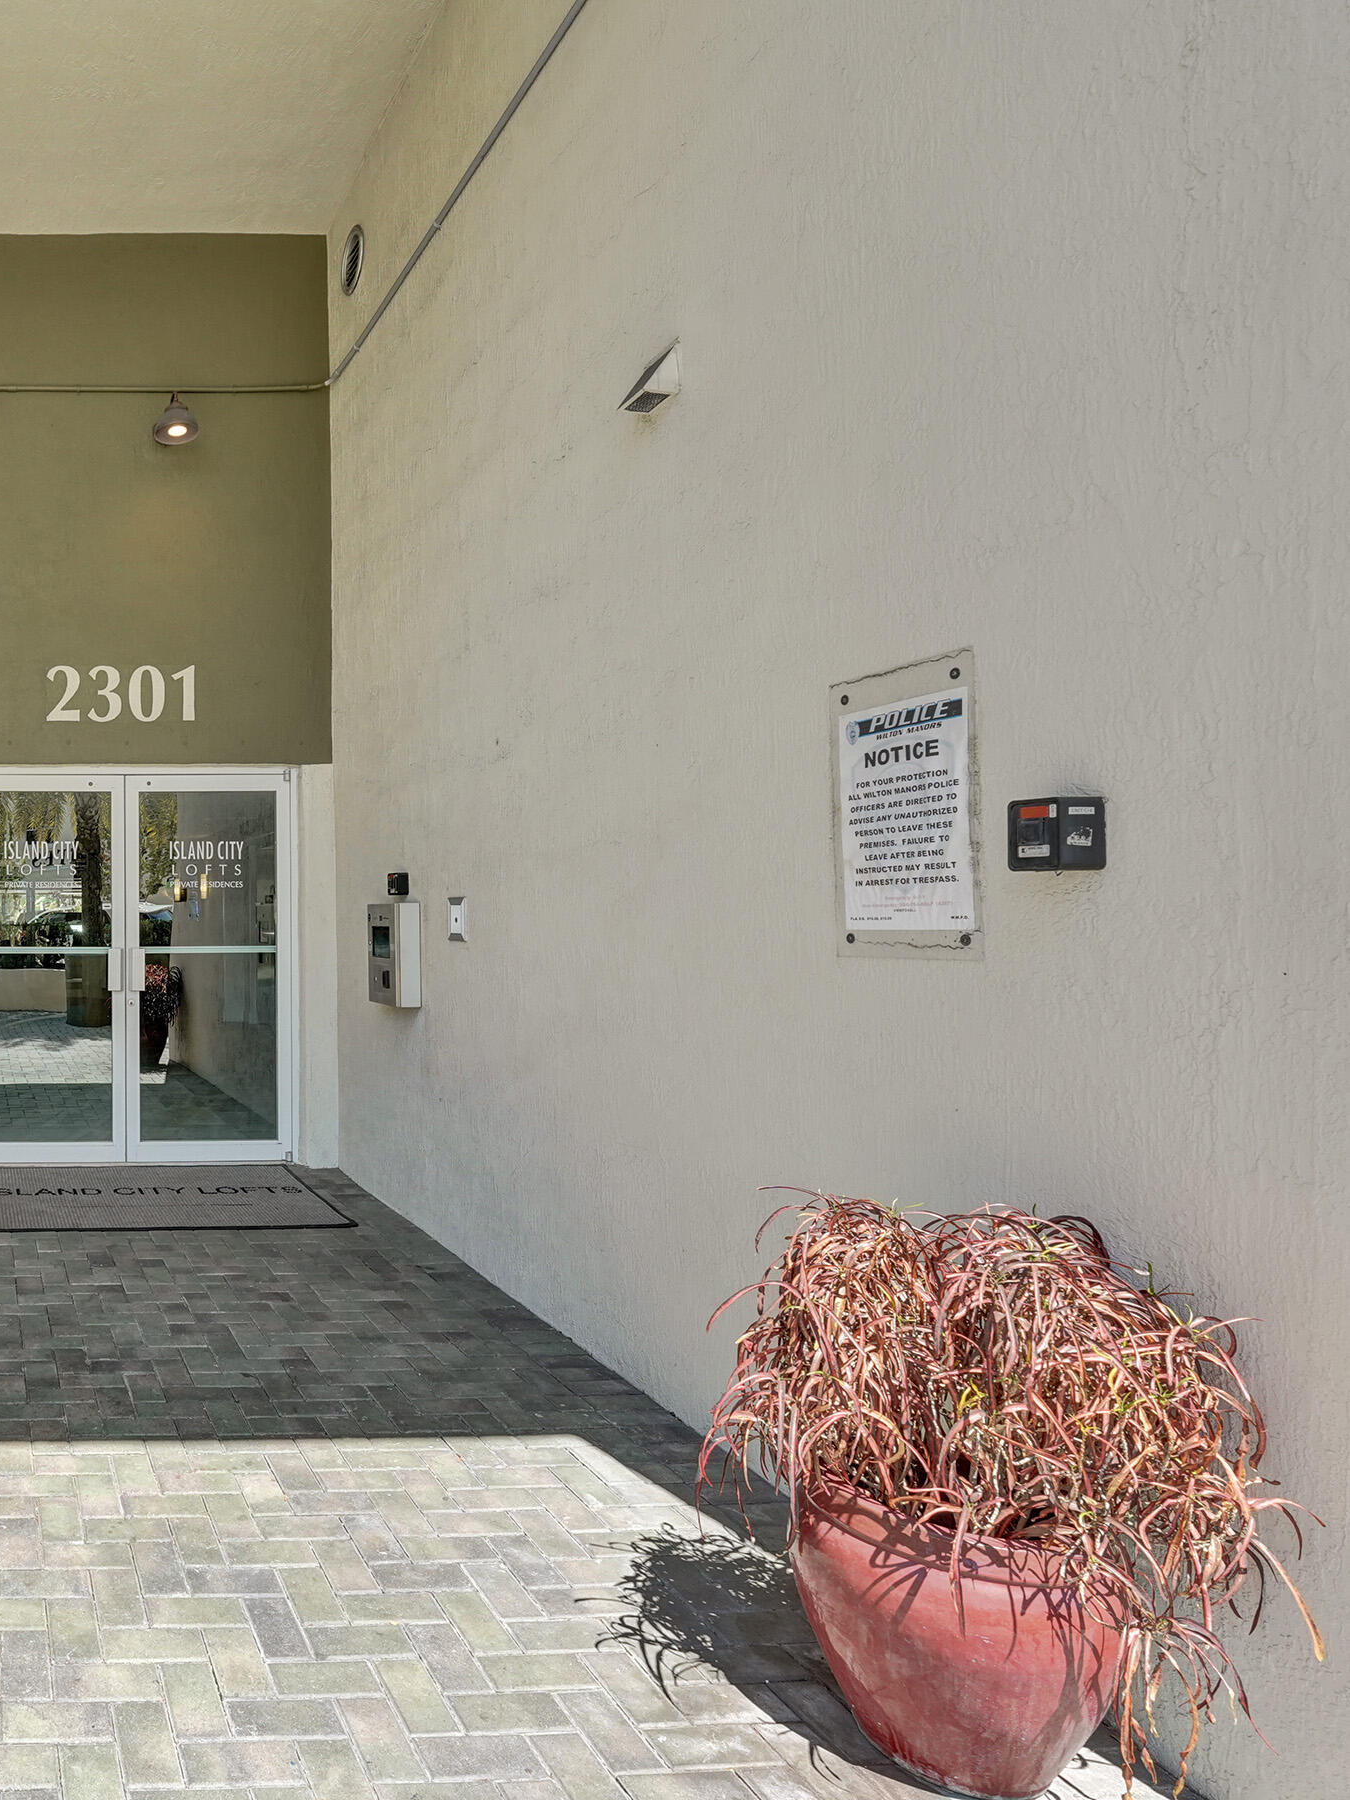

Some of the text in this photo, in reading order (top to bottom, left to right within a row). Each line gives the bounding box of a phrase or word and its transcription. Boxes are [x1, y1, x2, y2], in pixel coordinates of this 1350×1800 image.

[46, 664, 195, 723] 2301
[869, 698, 951, 733] POLICE
[876, 721, 943, 740] WILTON MANORS
[864, 739, 939, 768] NOTICE
[856, 769, 948, 790] FOR YOUR PROTECTION
[863, 789, 892, 799] WILTON
[894, 784, 926, 794] MANORS
[927, 778, 960, 789] POLICE
[850, 792, 957, 814] OFFICERS ARE DIRECTED TO
[849, 806, 958, 826] ADVISE ANY UNAUTHORIZED
[855, 820, 953, 837] PERSON TO LEAVE THESE
[3, 840, 80, 860] ISLAND CITY
[169, 840, 244, 860] ISLAND CITY
[859, 834, 950, 849] PREMISES. FAILURE TO
[865, 849, 944, 861] LEAVE AFTER BEING
[6, 864, 77, 876] LOFTS
[171, 864, 242, 876] LOFTS
[856, 861, 956, 874] INSTRUCTED MAY RESULT
[865, 878, 893, 886] ARREST
[895, 877, 910, 885] FOR
[912, 875, 959, 884] TRESPASS.
[113, 1185, 184, 1196] CITY
[197, 1184, 304, 1196] LOFTS
